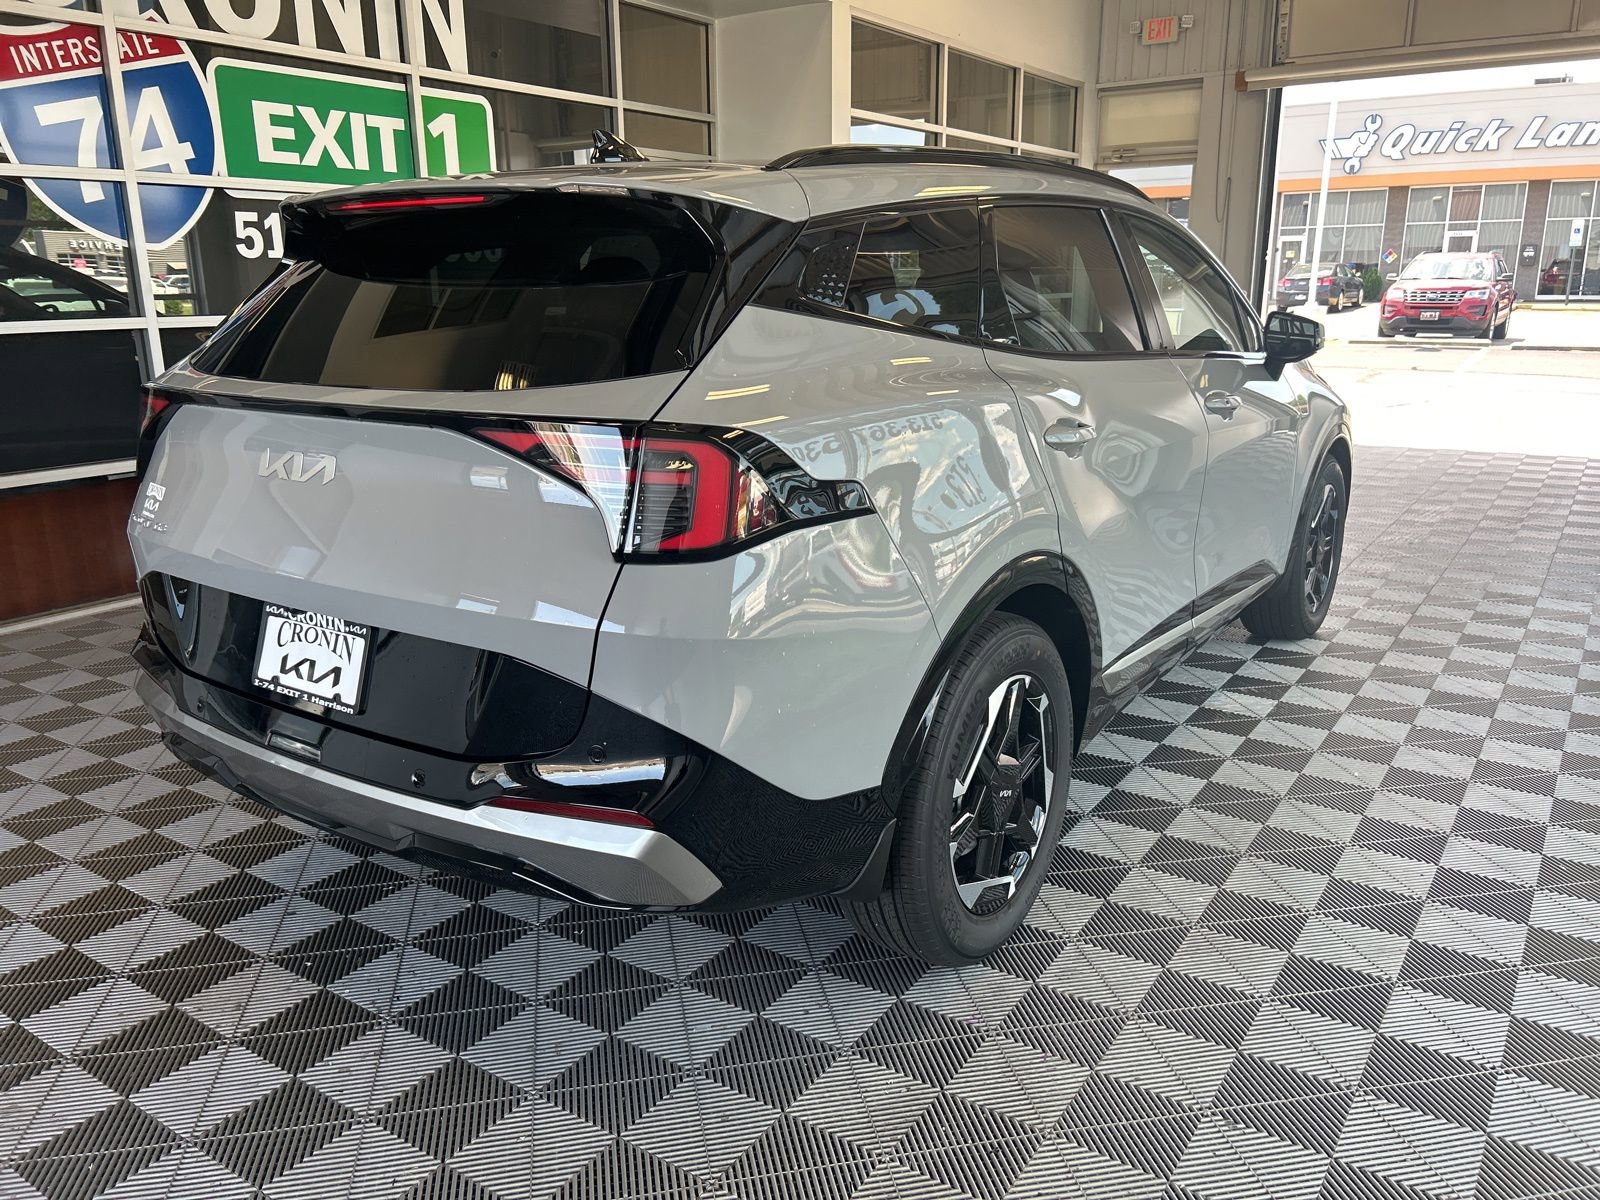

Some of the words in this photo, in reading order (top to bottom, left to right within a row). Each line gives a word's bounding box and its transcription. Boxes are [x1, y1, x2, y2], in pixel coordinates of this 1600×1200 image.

[1147, 16, 1175, 41] EXIT
[9, 32, 160, 74] INTERSATE
[33, 86, 196, 204] 74
[251, 99, 406, 173] EXIT
[426, 112, 460, 177] 1
[1380, 118, 1515, 160] Quick
[258, 447, 337, 486] KIA
[144, 497, 160, 512] KIA
[266, 605, 284, 615] KIA
[350, 624, 367, 635] KIA
[277, 621, 356, 665] CRONIN
[279, 653, 342, 689] KIA
[254, 678, 275, 691] I-74
[276, 685, 301, 698] EXIT
[311, 695, 354, 715] Harrison
